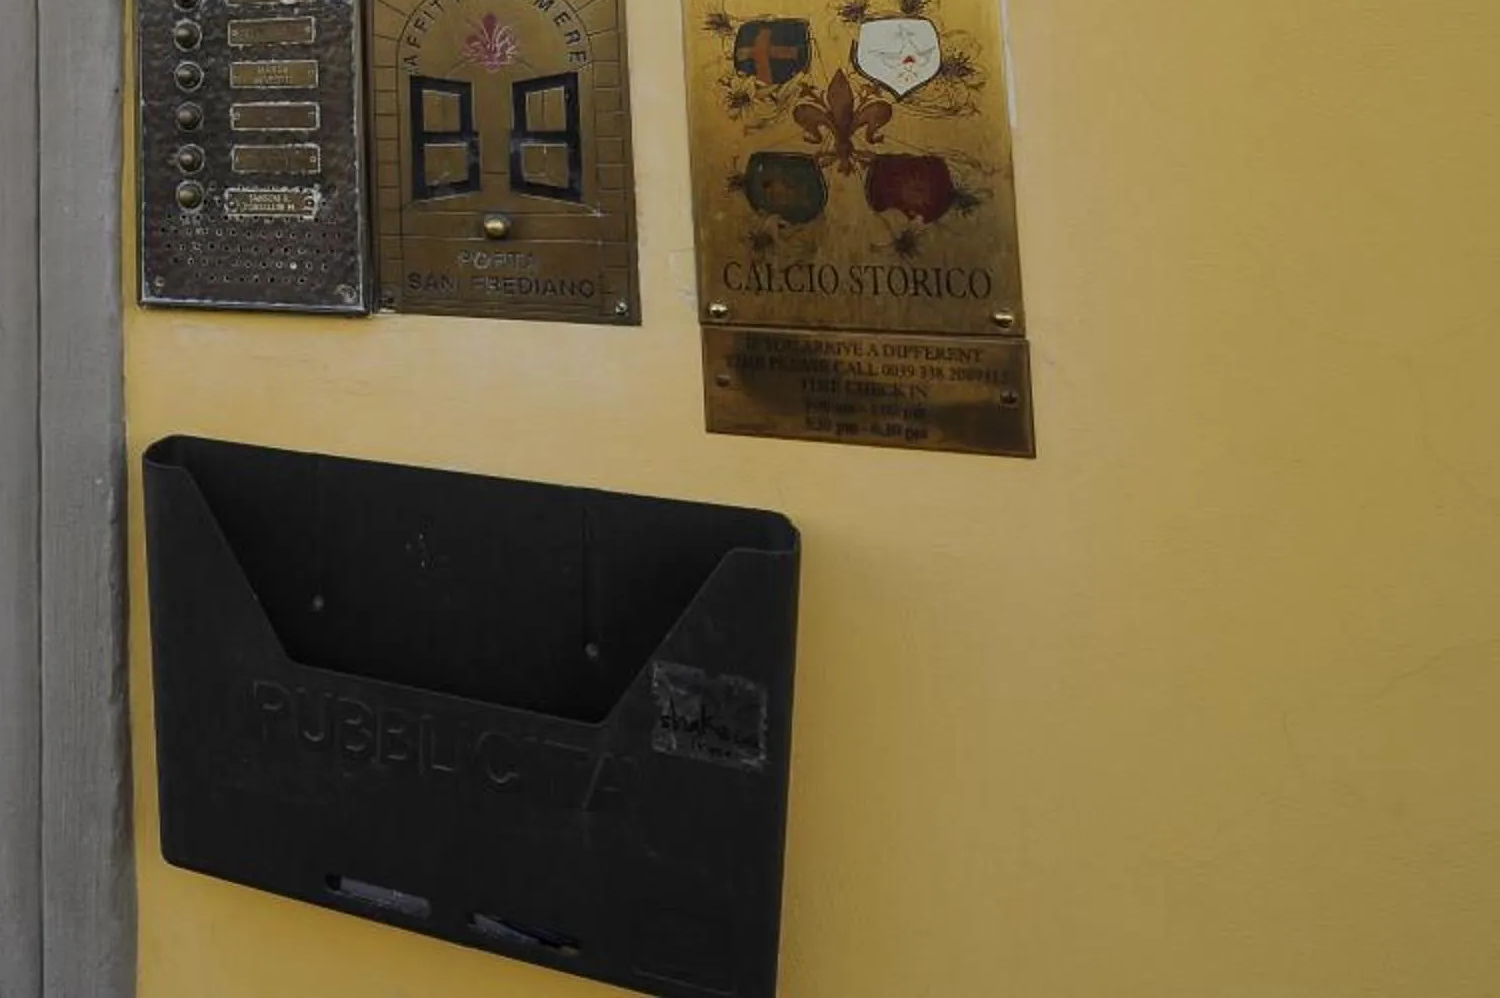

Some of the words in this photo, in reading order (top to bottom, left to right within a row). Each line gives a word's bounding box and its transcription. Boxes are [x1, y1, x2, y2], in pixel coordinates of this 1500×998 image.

[406, 271, 459, 291] SAN
[470, 276, 596, 300] FREDIANO
[723, 262, 839, 295] CALCIO
[849, 265, 991, 299] STORICO
[867, 344, 879, 356] A
[881, 344, 984, 363] DIFFERENT
[833, 359, 878, 376] CALL
